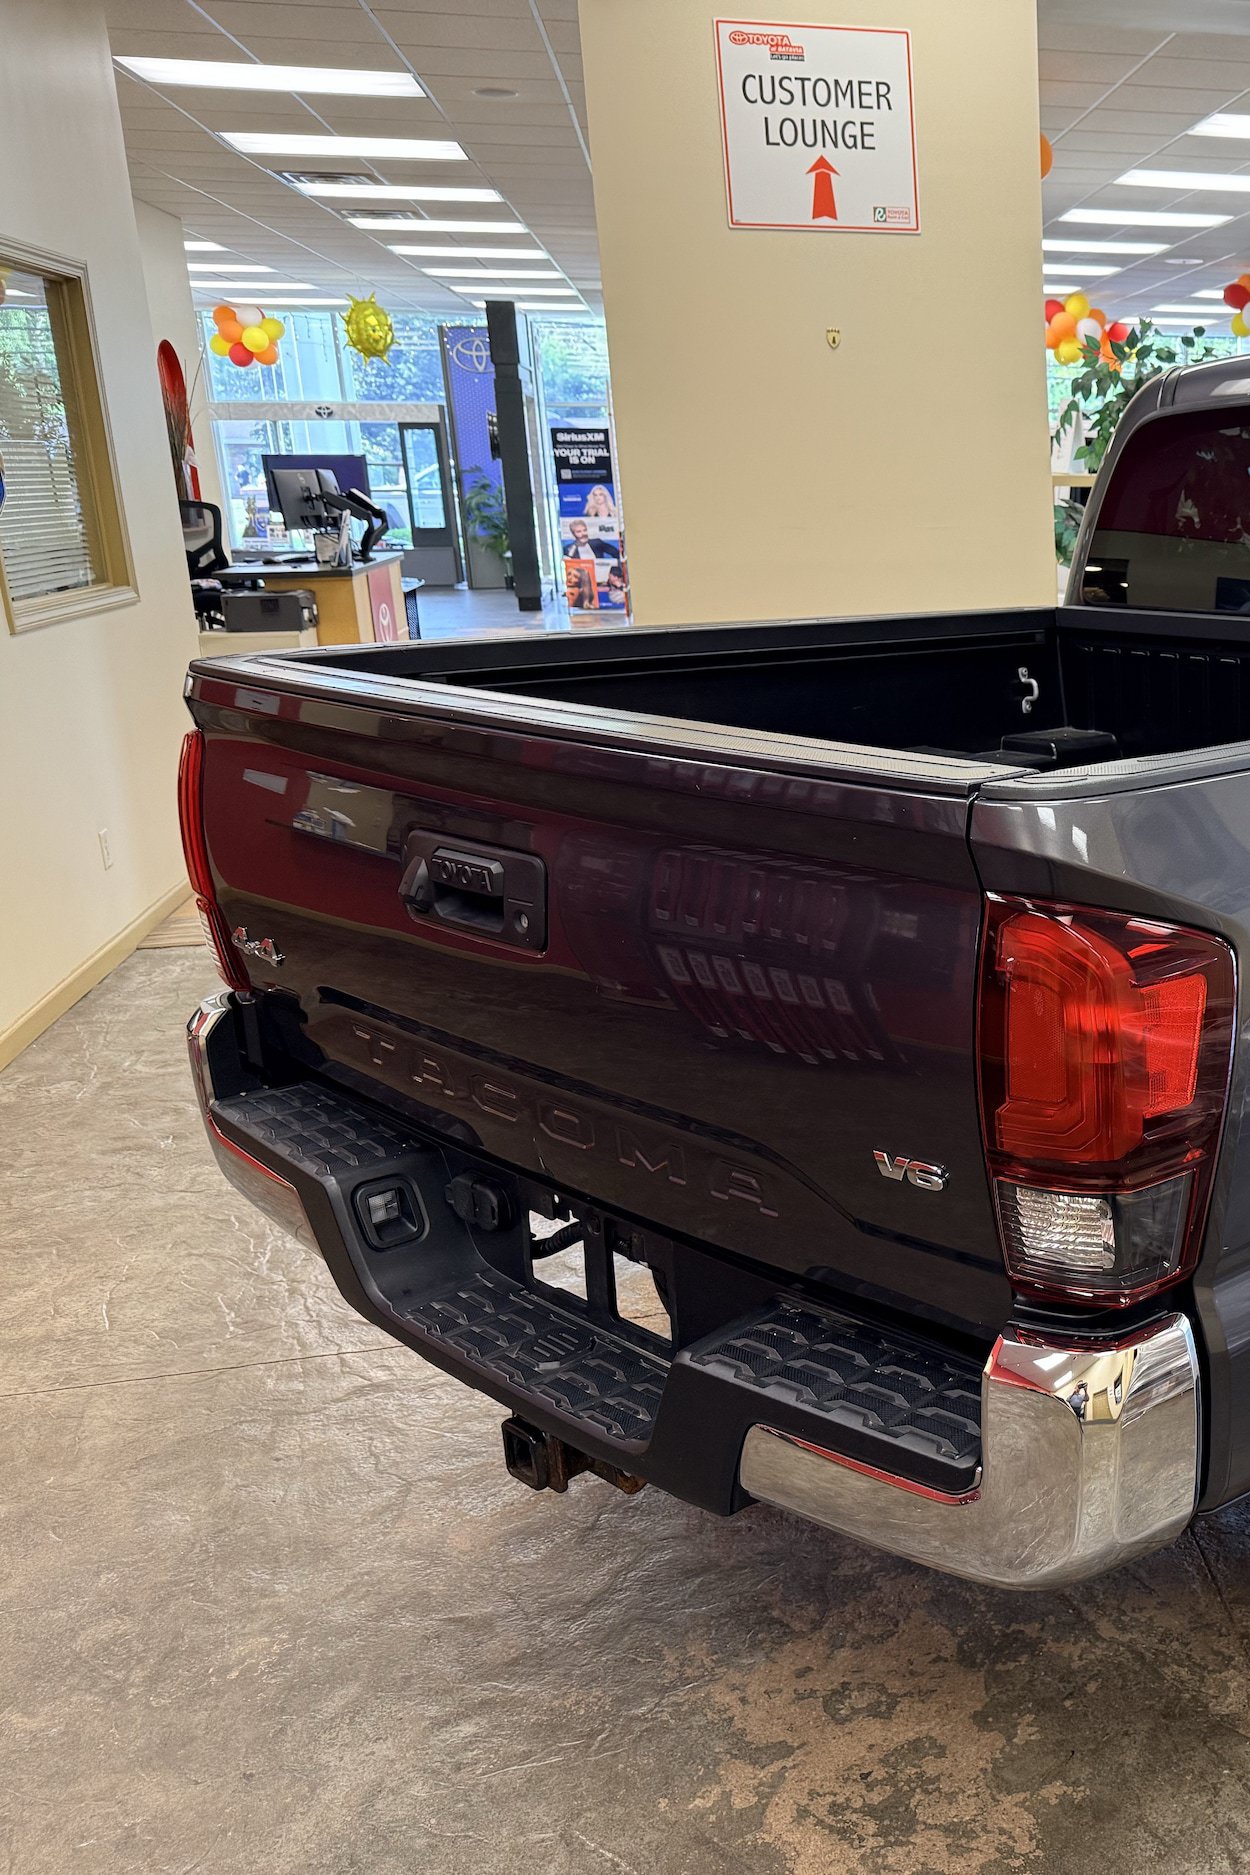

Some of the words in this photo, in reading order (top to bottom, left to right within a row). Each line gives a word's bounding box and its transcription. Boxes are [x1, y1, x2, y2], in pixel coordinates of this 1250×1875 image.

[747, 34, 791, 46] TOYOTA
[742, 74, 893, 111] CUSTOMER
[764, 117, 876, 150] LOUNGE
[554, 448, 581, 457] YOUR
[581, 448, 610, 457] TRIAL
[556, 432, 605, 442] SiriusXM
[568, 456, 580, 464] IS
[580, 456, 596, 464] ON
[431, 858, 492, 893] TOYOTA
[350, 1022, 780, 1218] TACOMA
[873, 1149, 949, 1192] V6
